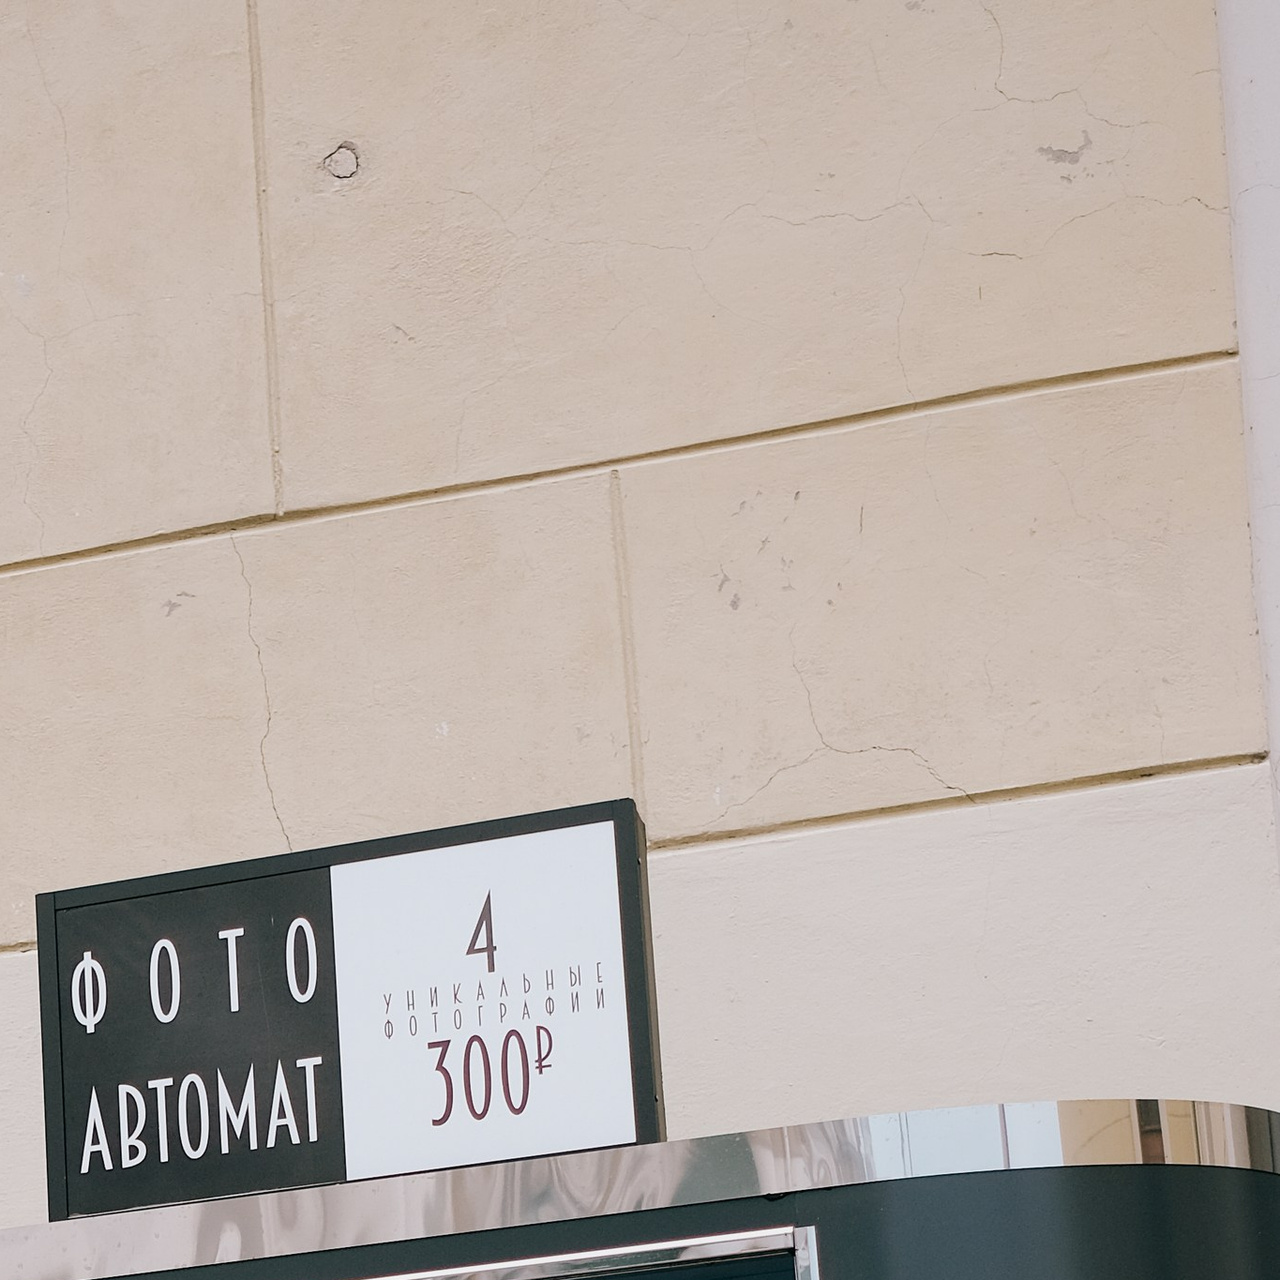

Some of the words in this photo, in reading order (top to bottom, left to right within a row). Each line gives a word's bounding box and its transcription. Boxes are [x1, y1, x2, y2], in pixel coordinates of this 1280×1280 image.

[71, 917, 319, 1034] ФОТО
[466, 889, 497, 973] 4
[383, 962, 604, 1014] УНИКАЛЬНЫЕ
[384, 988, 605, 1040] ФОТОГРАФИИ
[80, 1056, 323, 1175] АВТОМАТ
[427, 1025, 553, 1126] 300₽
